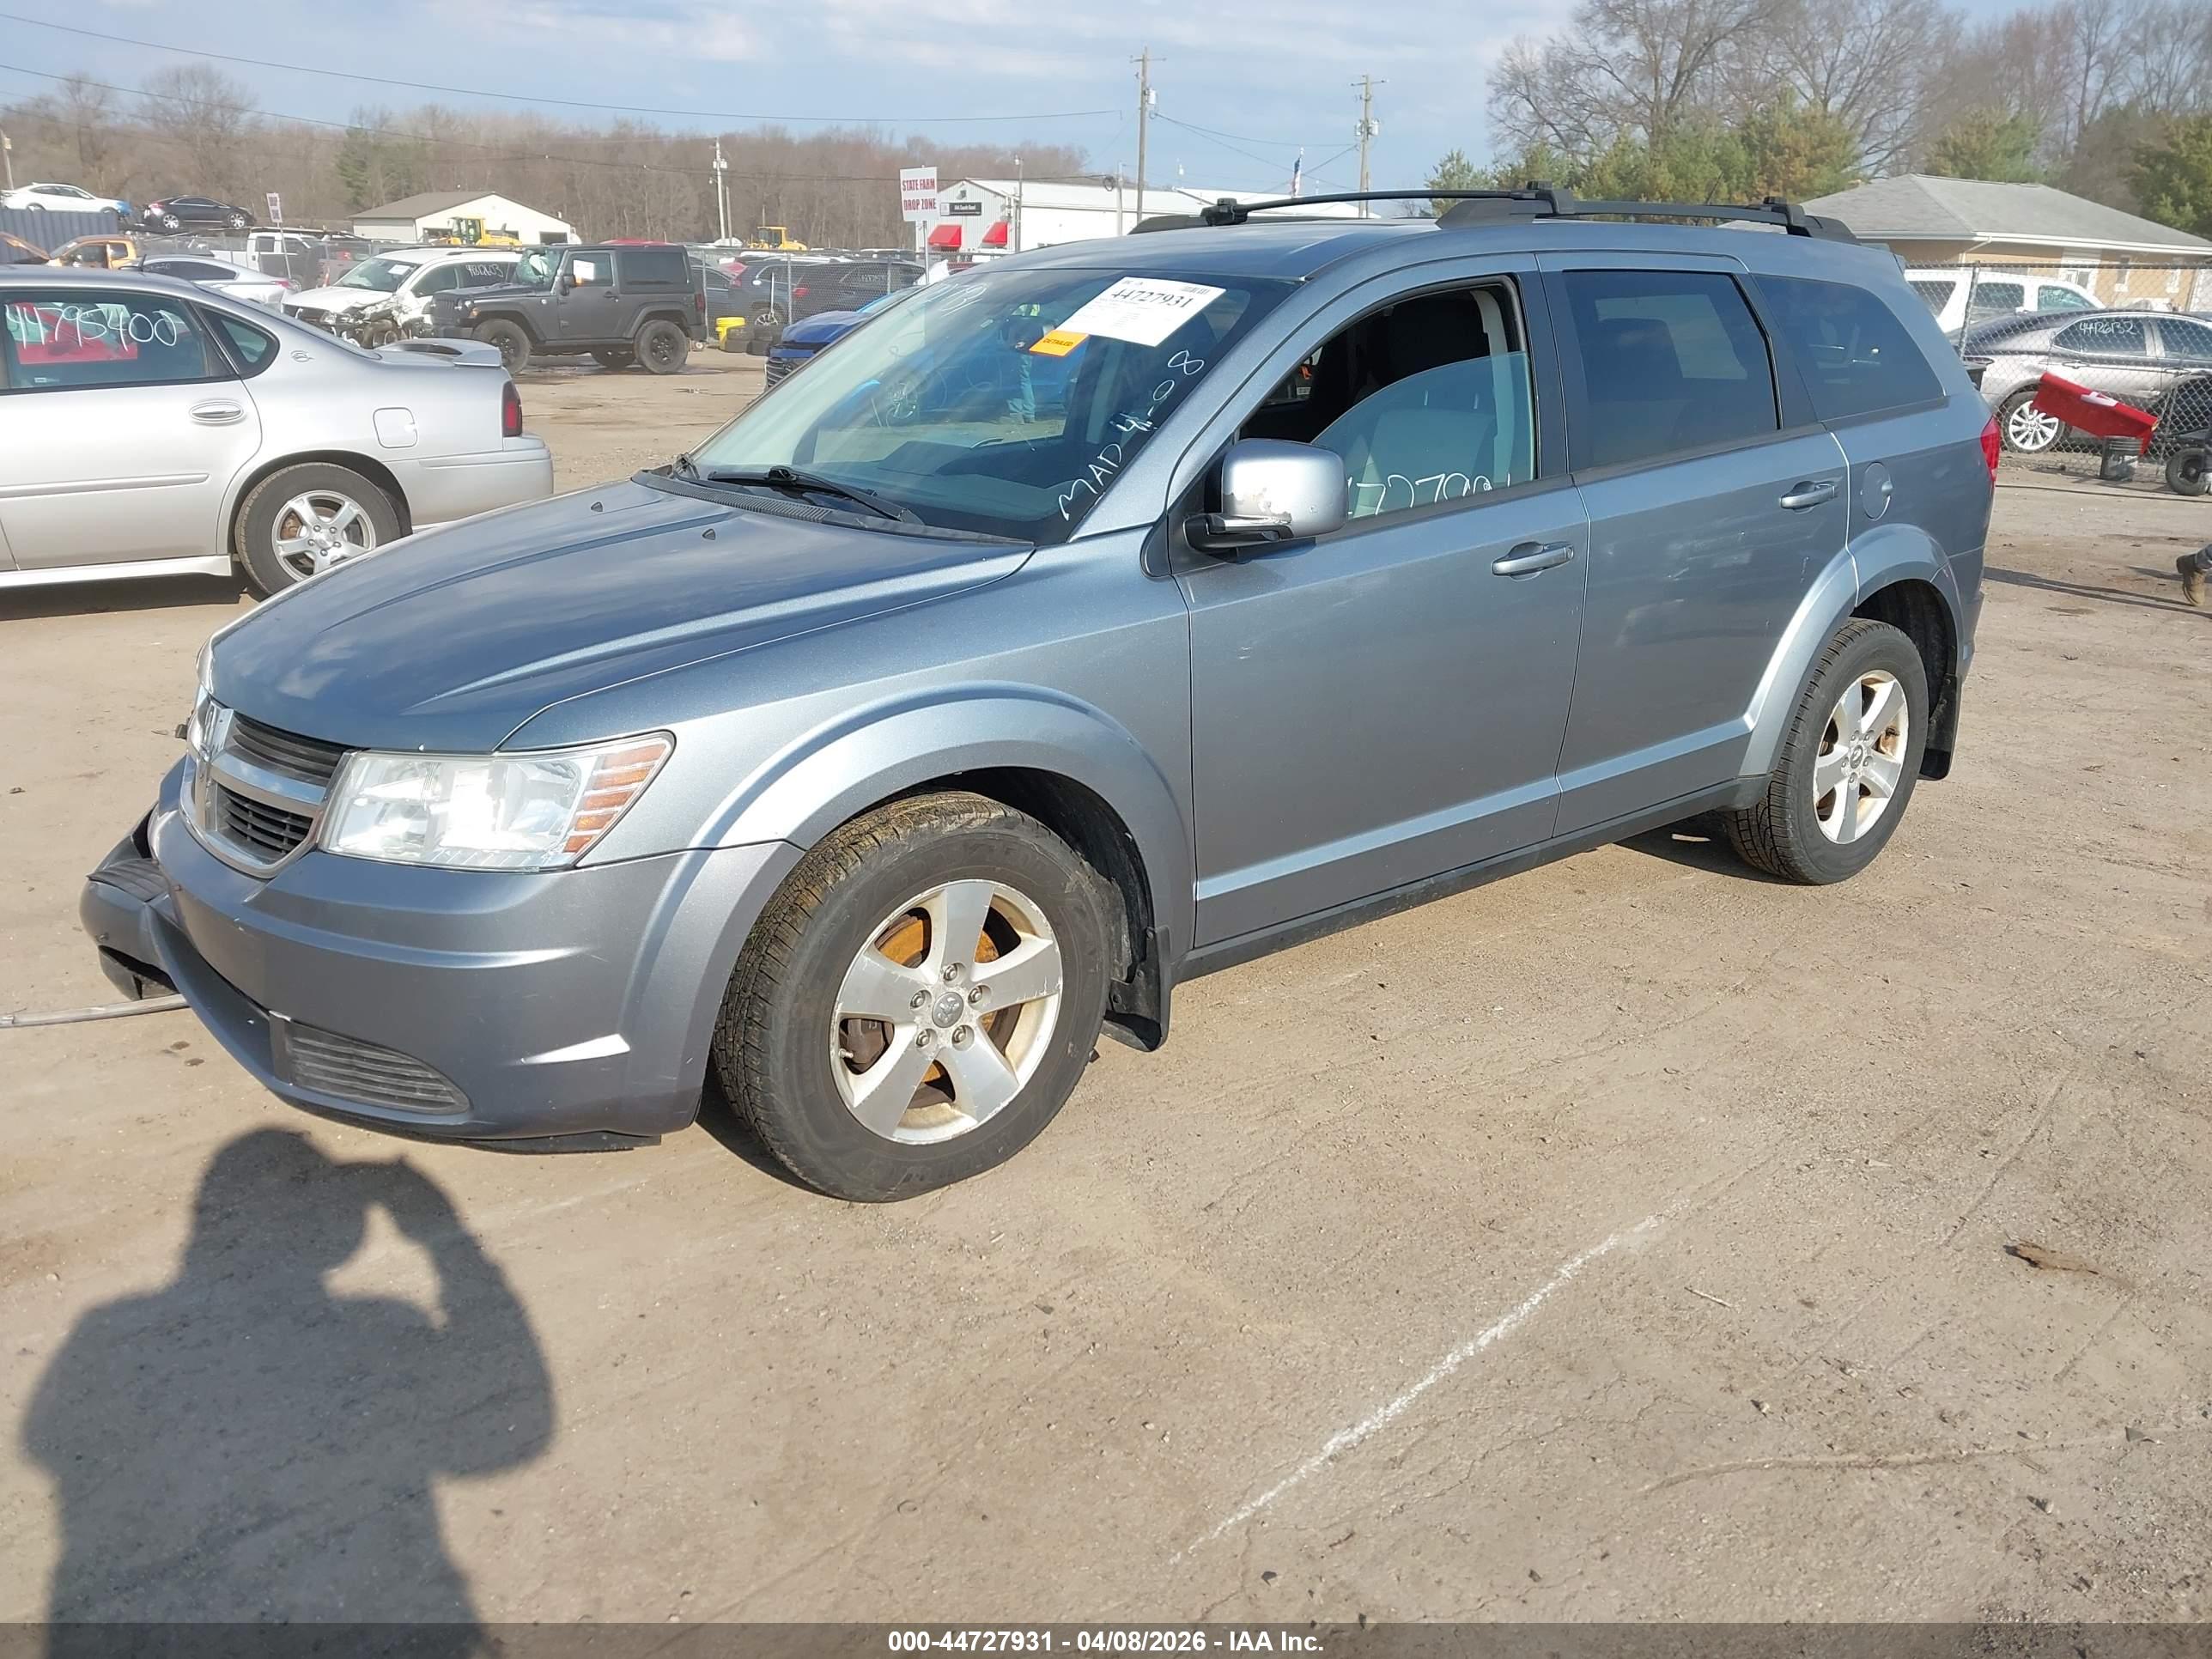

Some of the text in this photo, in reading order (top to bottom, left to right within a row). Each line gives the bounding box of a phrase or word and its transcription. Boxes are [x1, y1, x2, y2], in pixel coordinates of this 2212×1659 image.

[902, 178, 935, 191] STATE FARM
[903, 198, 937, 210] DROP ZONE
[1110, 288, 1194, 308] 44727931
[4, 303, 177, 349] 44795400
[1058, 442, 1122, 521] MAD
